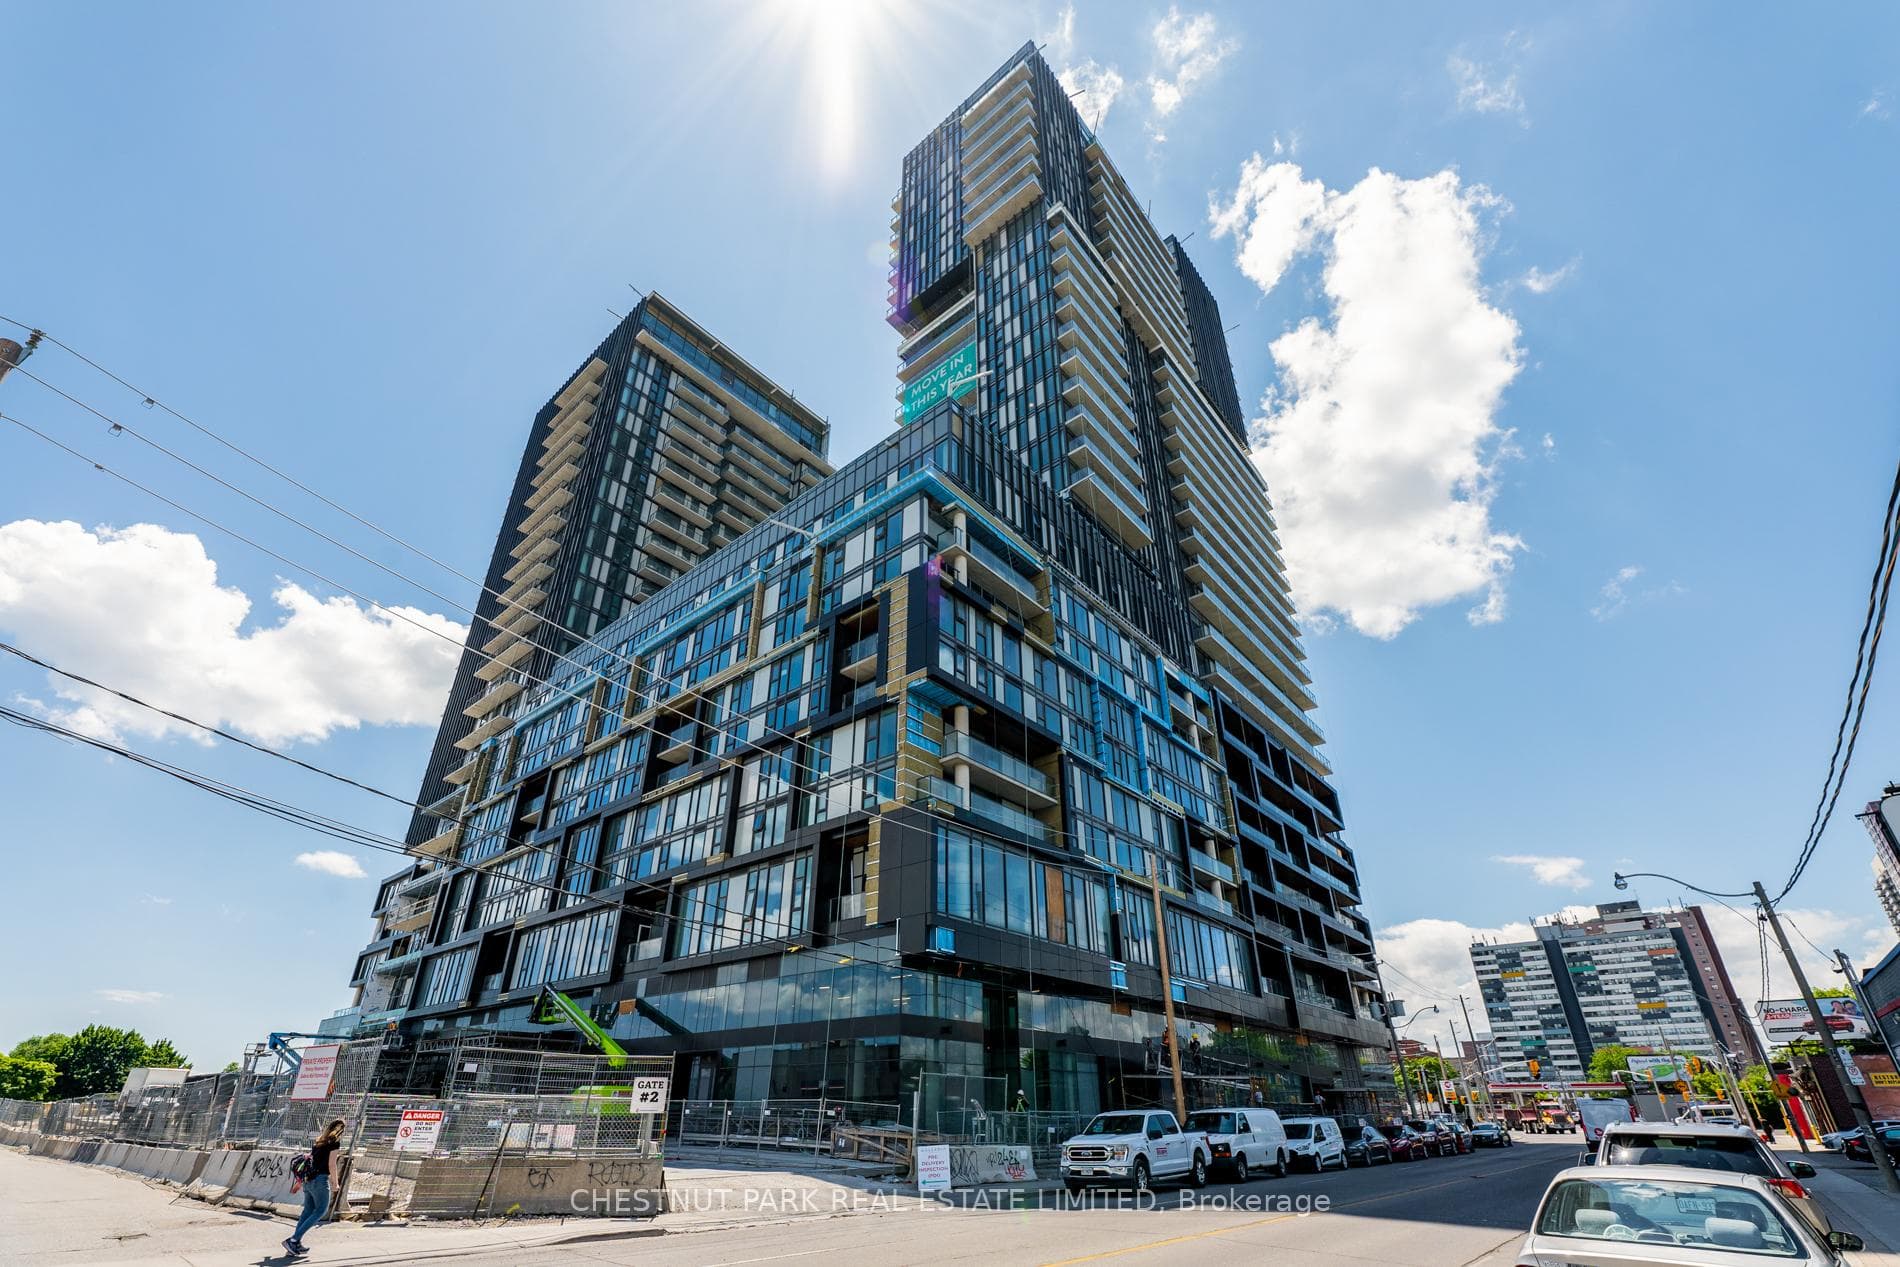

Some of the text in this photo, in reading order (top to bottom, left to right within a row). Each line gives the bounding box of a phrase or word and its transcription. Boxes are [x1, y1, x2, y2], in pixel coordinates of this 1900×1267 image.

[911, 353, 964, 398] MOVE IN
[911, 363, 973, 412] THIS YEAR
[1763, 1005, 1809, 1014] NO-CHARG
[637, 1080, 664, 1089] GATE
[640, 1091, 659, 1103] #2
[413, 1112, 441, 1120] DANGER
